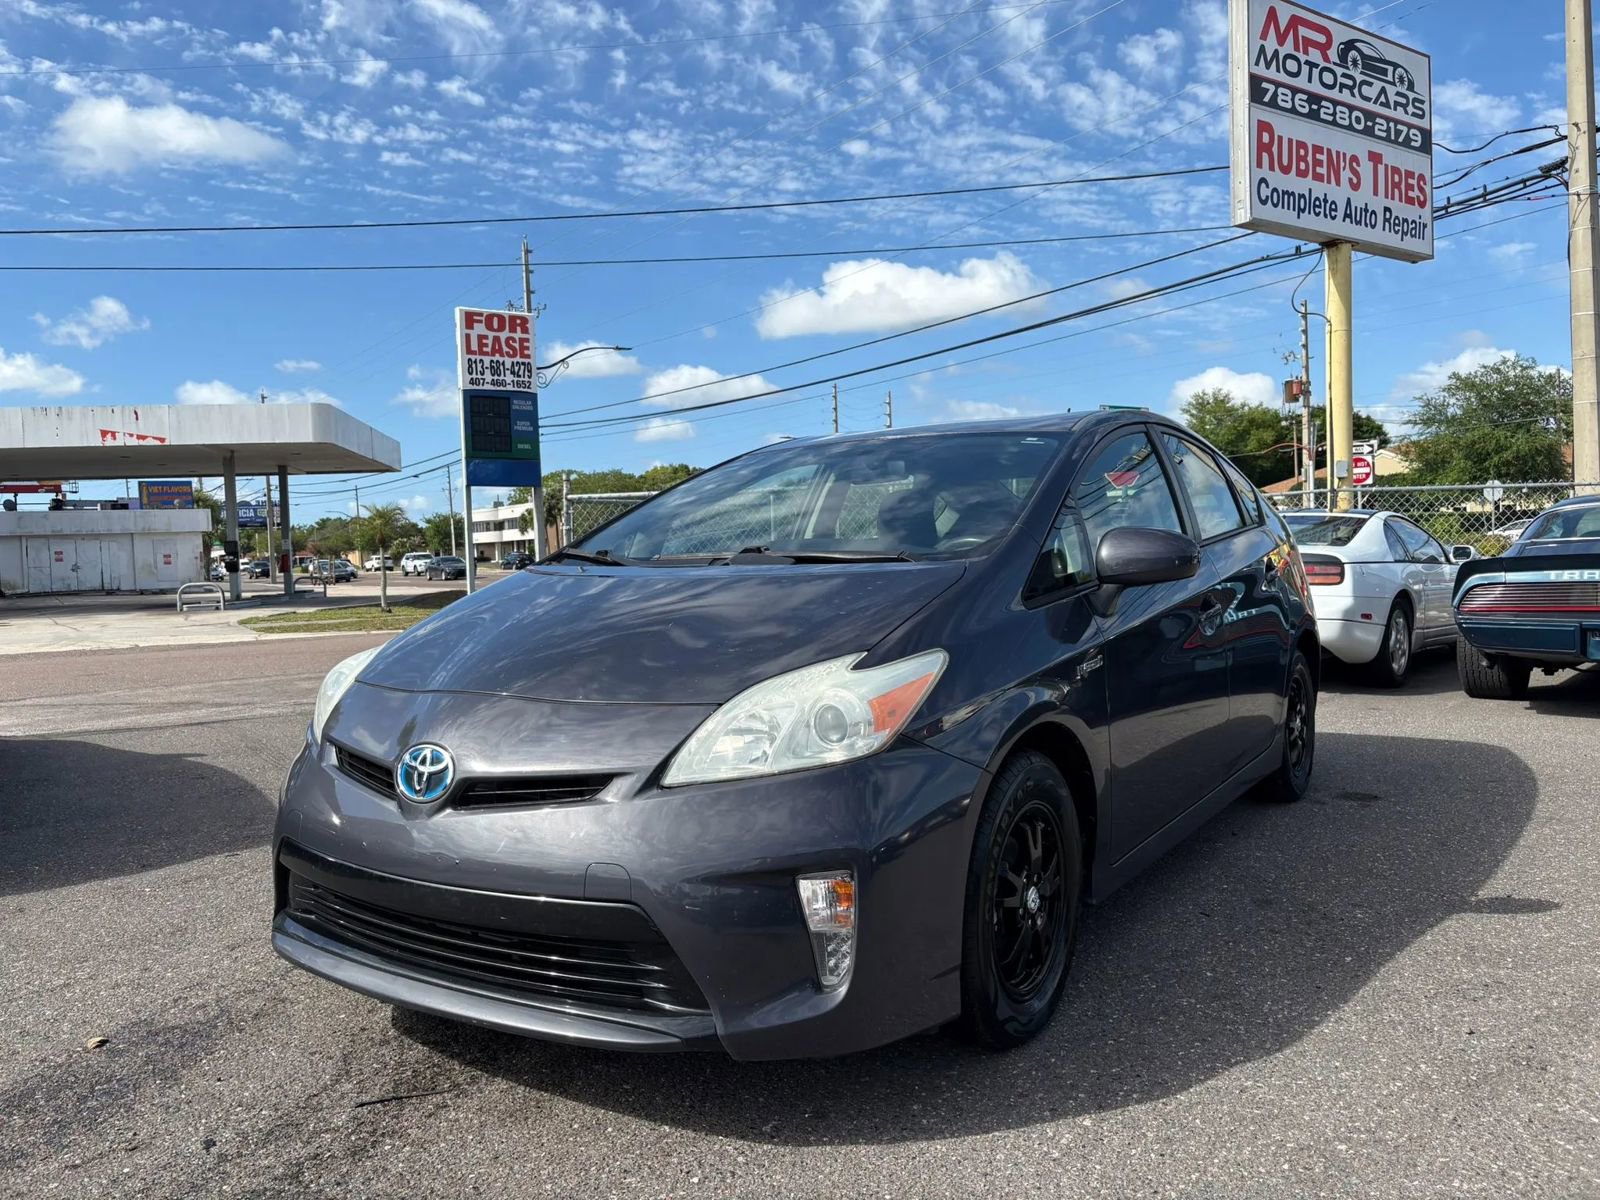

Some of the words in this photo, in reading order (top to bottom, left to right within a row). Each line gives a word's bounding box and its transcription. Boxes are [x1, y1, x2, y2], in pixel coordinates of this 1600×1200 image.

[1259, 5, 1334, 64] MR
[1254, 43, 1427, 120] MOTORCARS
[1260, 82, 1423, 148] 786-280-2179
[1256, 119, 1362, 192] RUBEN'S
[1368, 150, 1428, 209] TIRES
[1256, 176, 1338, 221] Complete
[1343, 197, 1378, 230] Auto
[1382, 206, 1428, 242] Repair
[464, 311, 530, 335] FOR
[465, 333, 531, 359] LEASE
[467, 357, 532, 380] 813-681-4279
[468, 377, 532, 390] 407-460-1652
